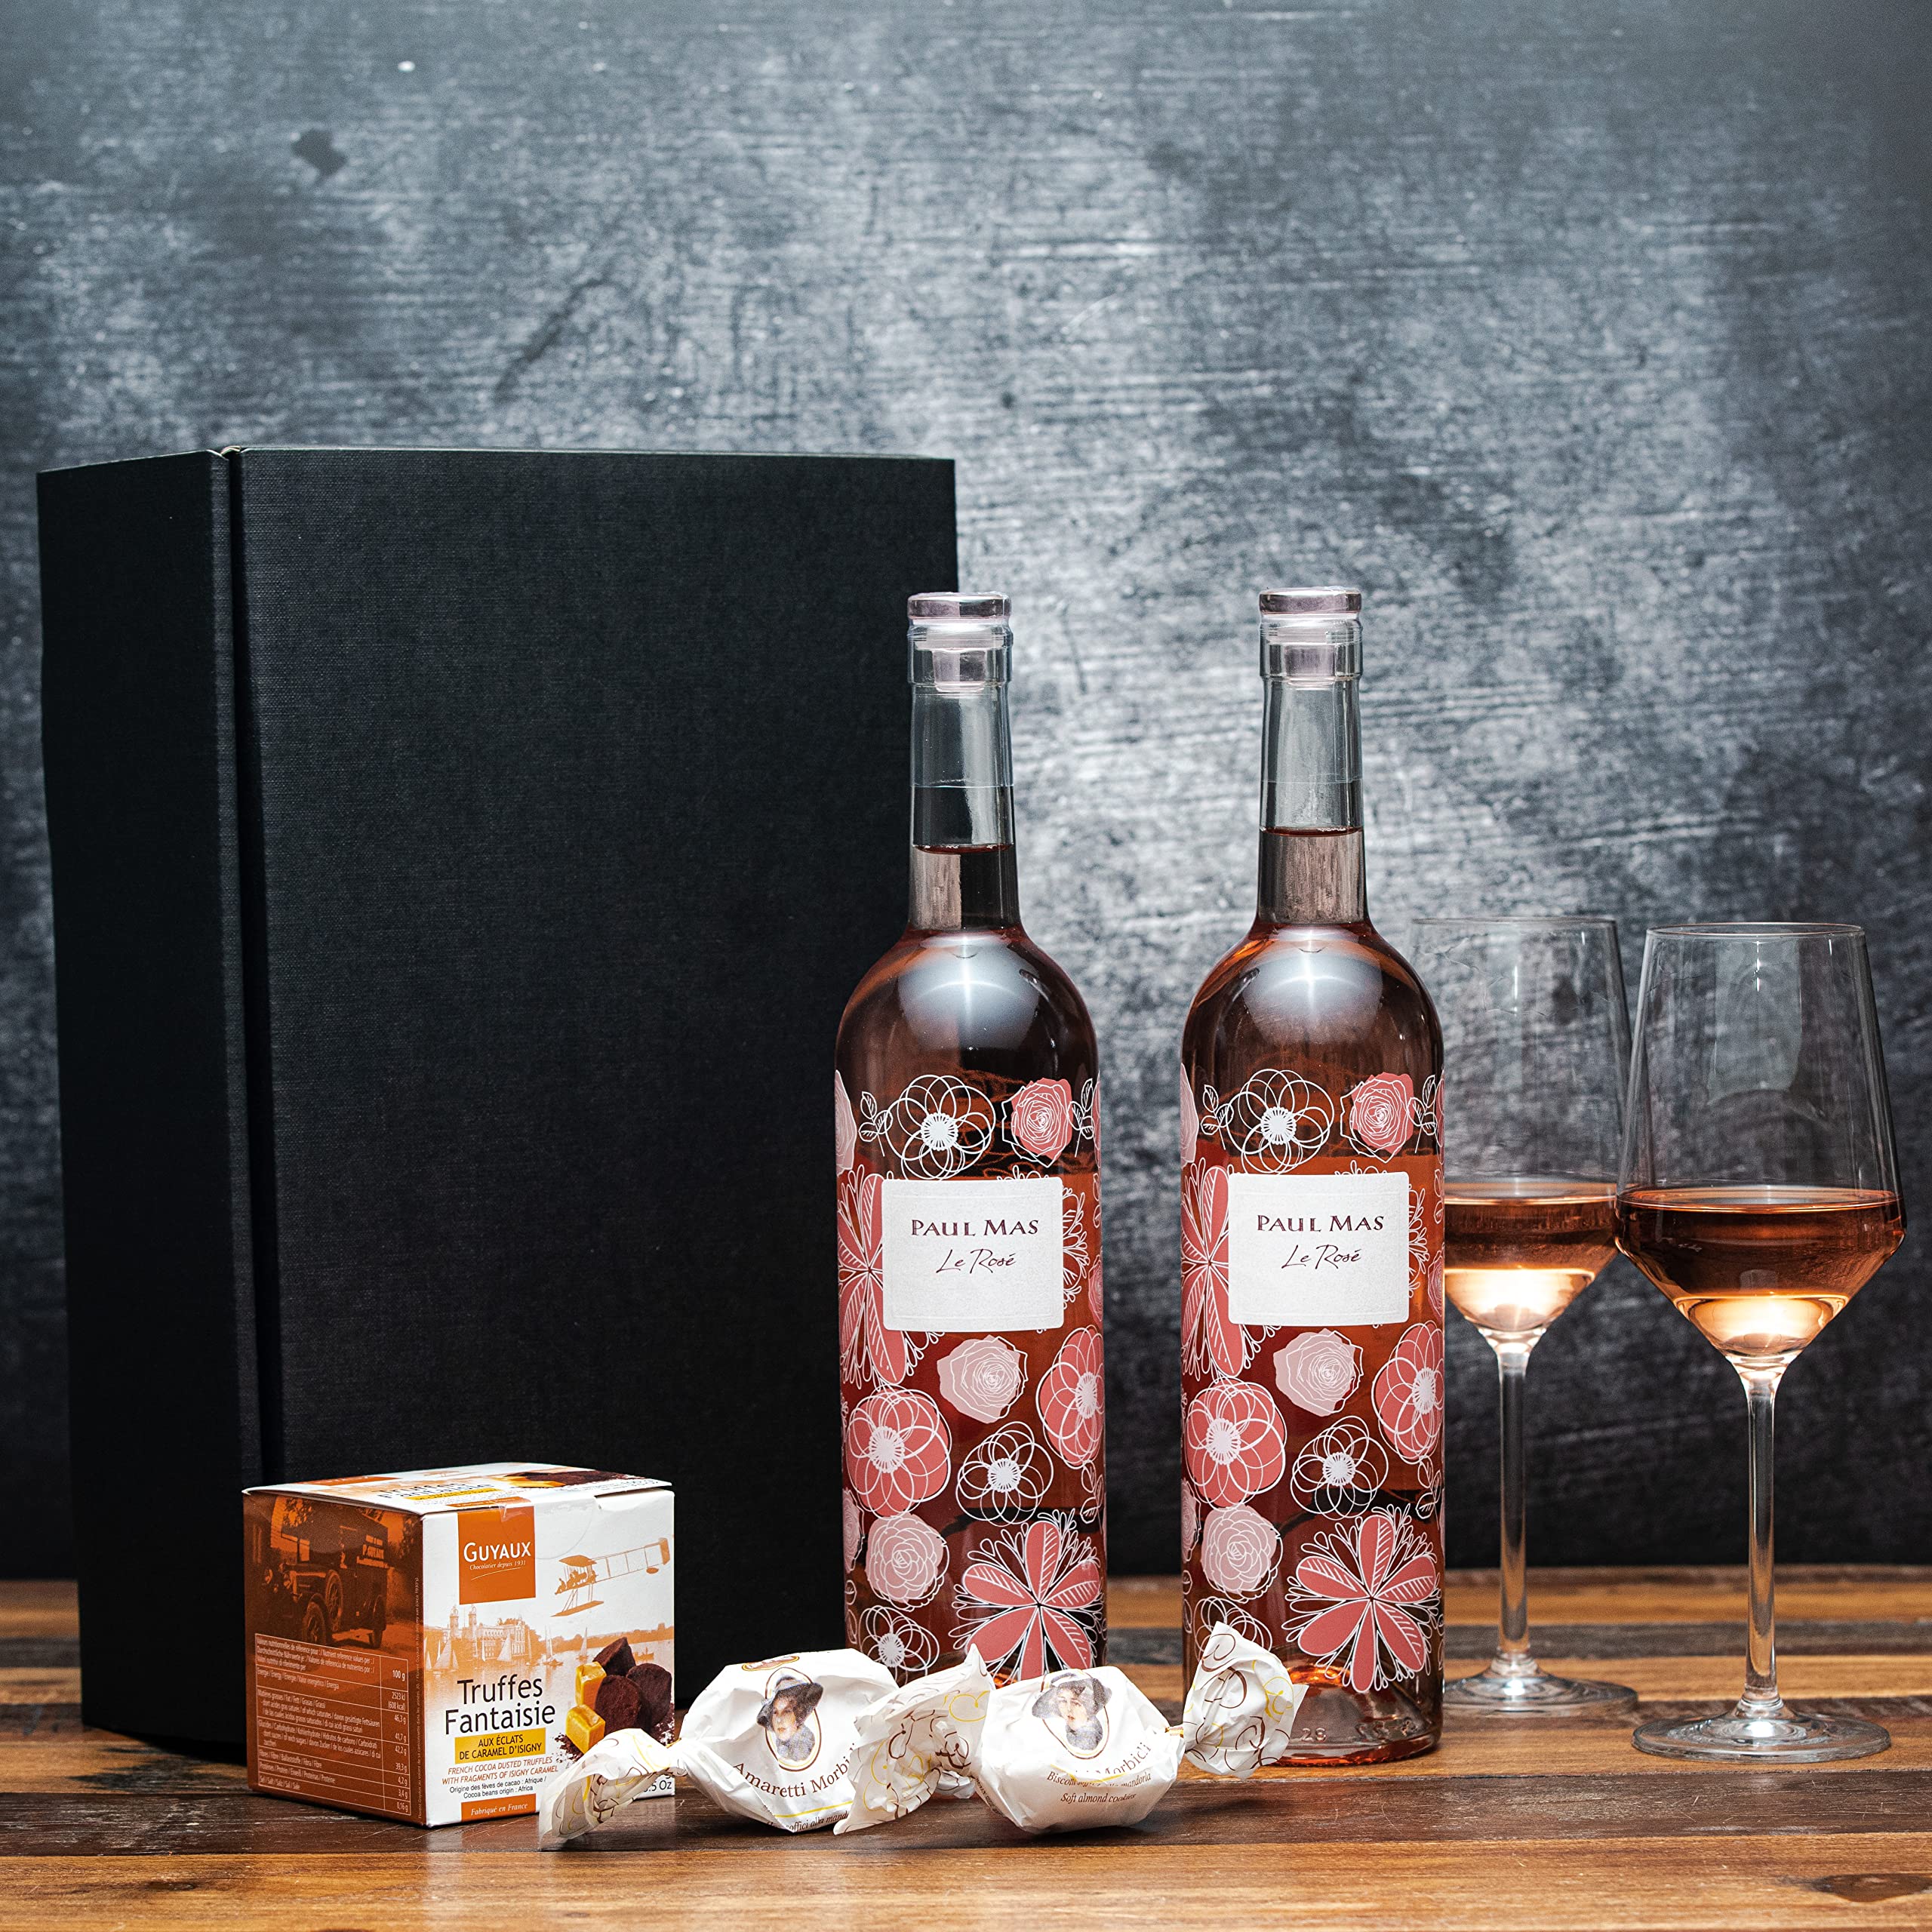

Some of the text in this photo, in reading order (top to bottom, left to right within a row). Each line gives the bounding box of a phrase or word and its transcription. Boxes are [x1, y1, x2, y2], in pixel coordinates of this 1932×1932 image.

[912, 1219, 1038, 1236] PAUL MAS
[1257, 1214, 1384, 1232] PAUL MAS
[936, 1248, 1017, 1274] Le Rosé
[1281, 1244, 1362, 1269] Le Rosé
[463, 1541, 531, 1562] GUYAUX
[469, 1562, 496, 1571] Chocolatier
[392, 1669, 401, 1679] 100
[457, 1674, 543, 1704] Truffes
[445, 1700, 555, 1735] Fantaisie
[478, 1734, 524, 1748] AUX ÉCLATS
[459, 1743, 542, 1760] DE CARAMEL D'ISIGNY
[448, 1756, 552, 1775] FRENCH COCOA DUSTED TRUFFLES
[442, 1777, 459, 1785] WITH
[460, 1773, 498, 1783] FRAGMENTS
[509, 1768, 529, 1777] ISIGNY
[531, 1765, 558, 1775] CARAMEL
[733, 1763, 806, 1798] Amaretti
[450, 1786, 469, 1794] Origine
[525, 1777, 543, 1785] Afrique
[659, 1780, 672, 1790] Oz
[1060, 1792, 1137, 1804] Soft almond cookies
[471, 1805, 497, 1816] Fabriqué
[508, 1802, 528, 1810] France
